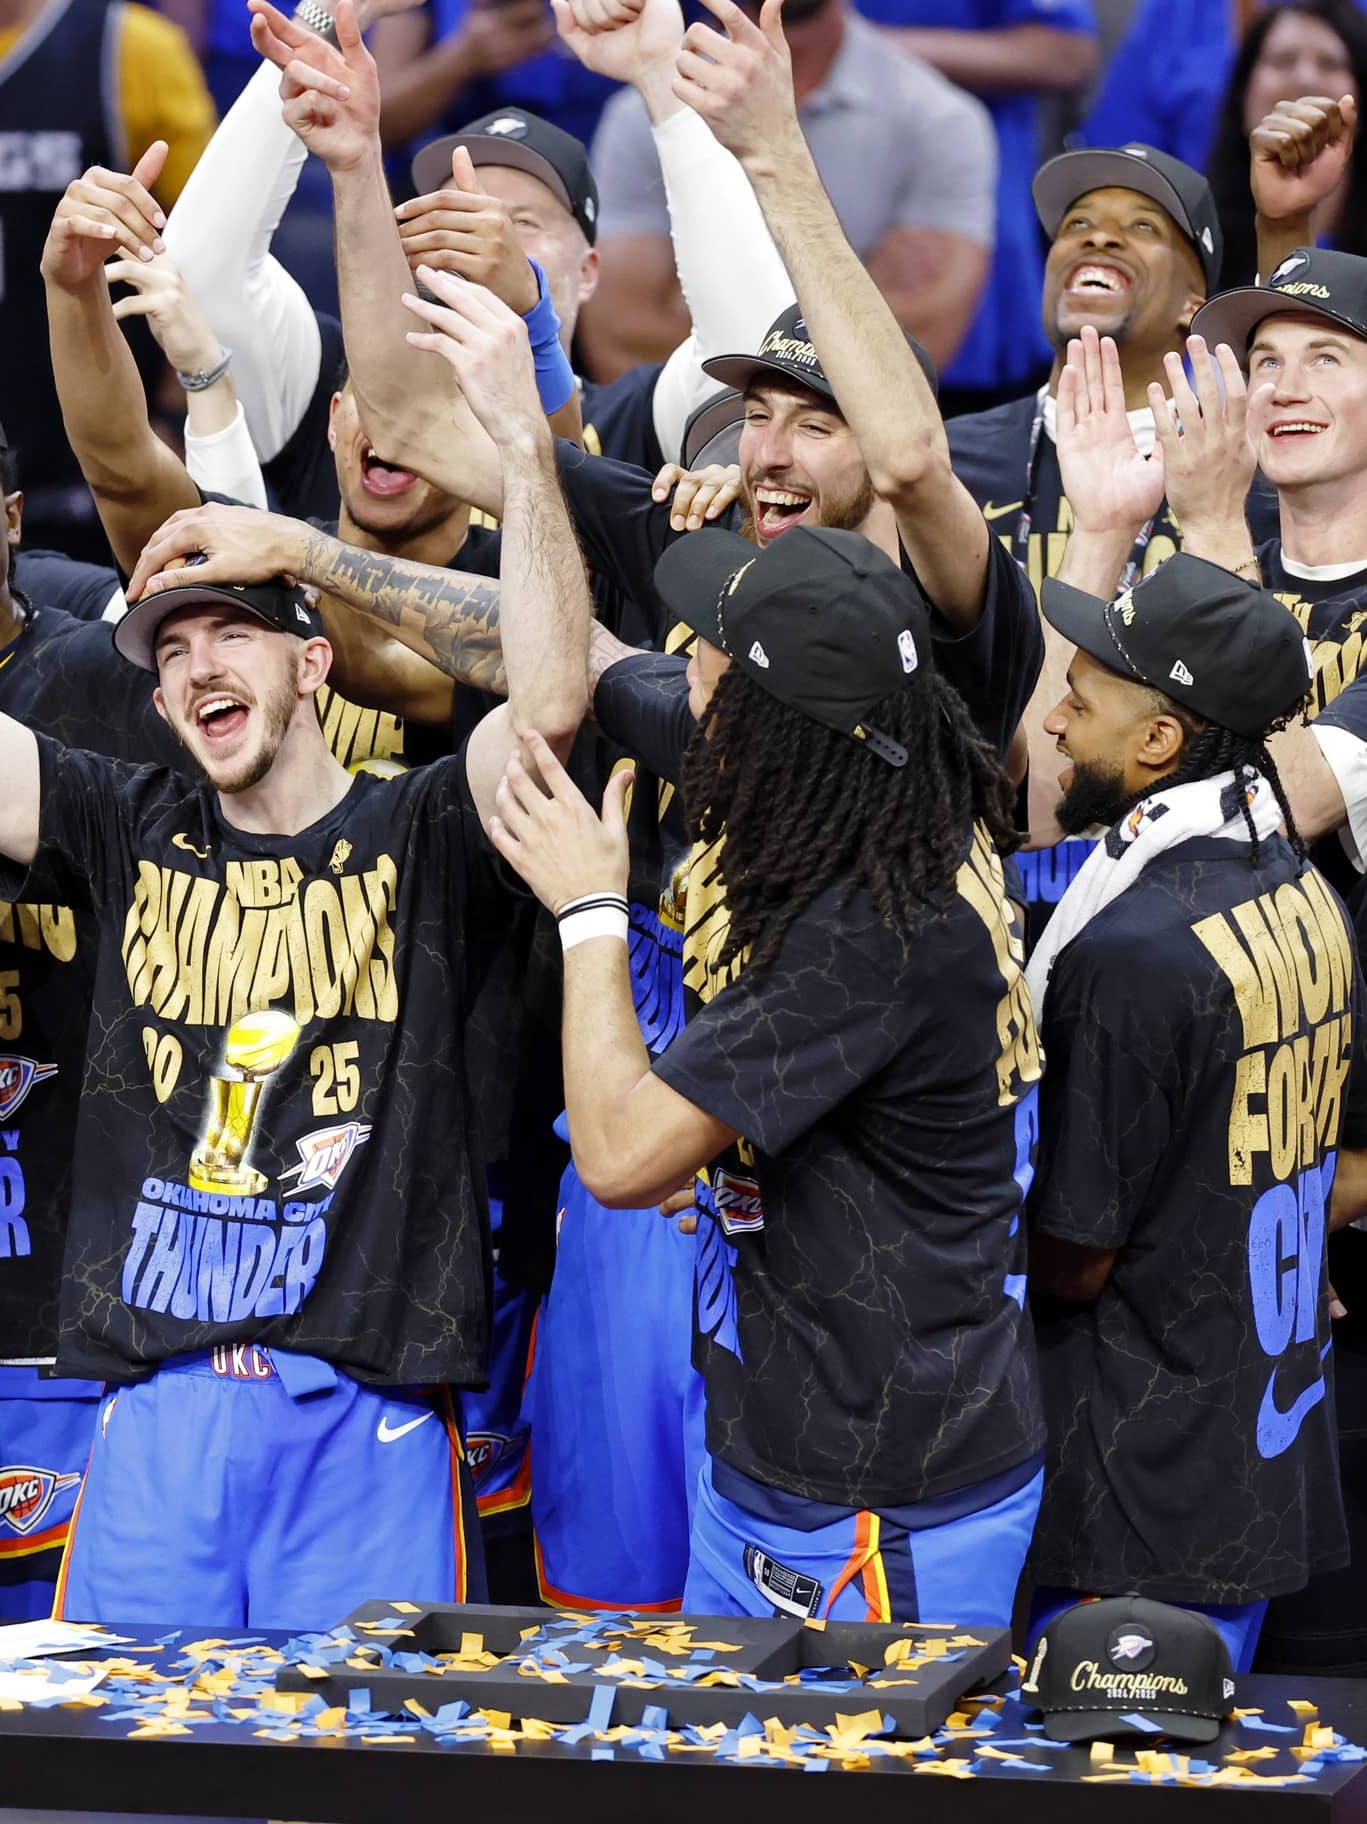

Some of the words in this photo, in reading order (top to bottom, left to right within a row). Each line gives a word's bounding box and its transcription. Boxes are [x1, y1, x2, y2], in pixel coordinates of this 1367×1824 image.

[226, 857, 305, 908] NBA
[310, 1040, 360, 1117] 25
[121, 1201, 328, 1324] THUNDER
[211, 1344, 274, 1379] OKC
[1070, 1660, 1188, 1699] Champions
